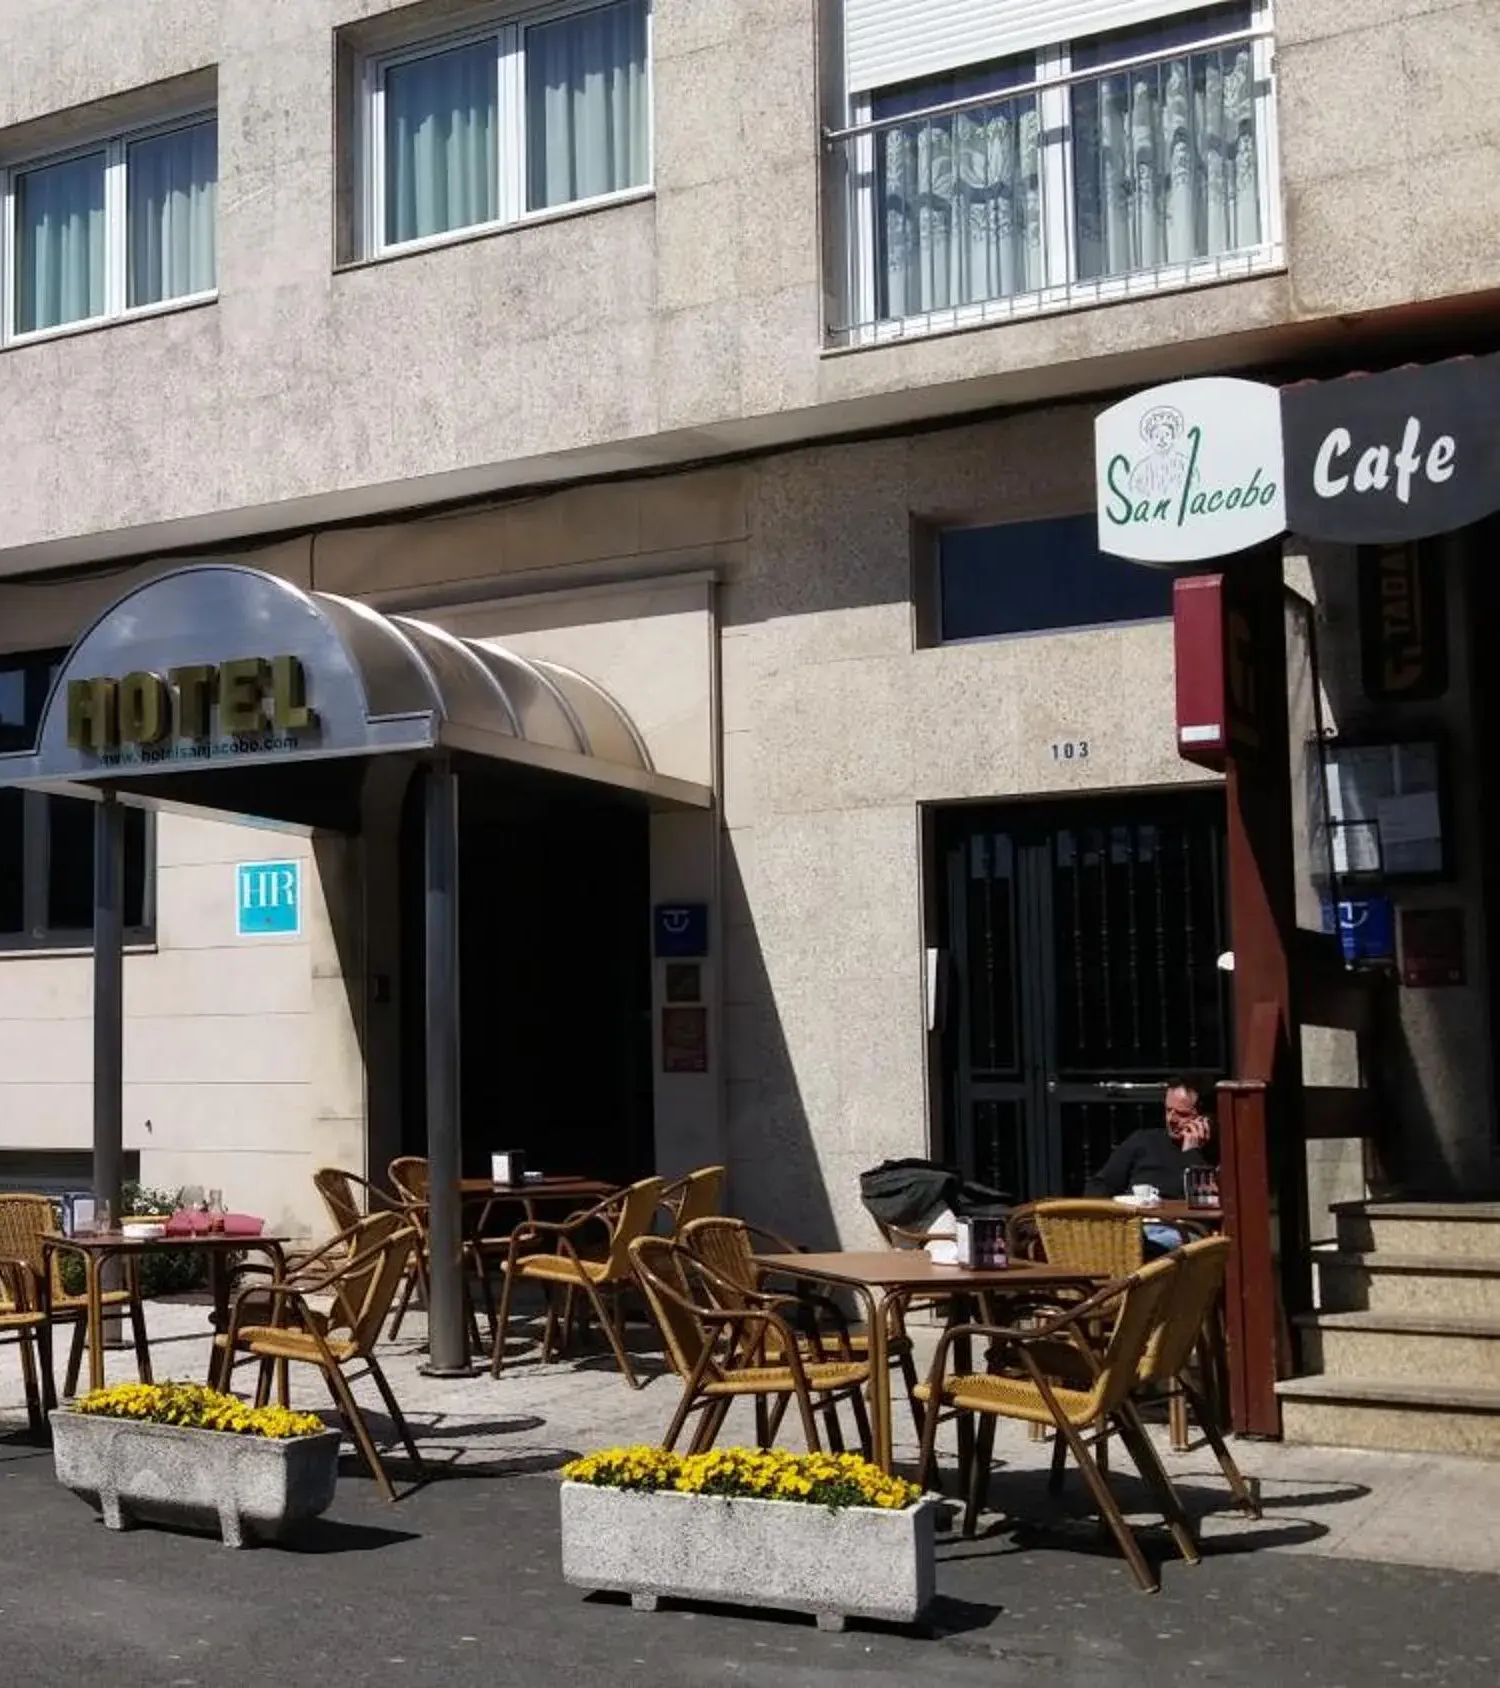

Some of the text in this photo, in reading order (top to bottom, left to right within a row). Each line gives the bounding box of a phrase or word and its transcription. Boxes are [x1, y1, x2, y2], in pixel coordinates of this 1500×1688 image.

[1106, 455, 1169, 525] San
[1313, 416, 1456, 504] Cafe
[67, 655, 315, 748] HOTEL
[1052, 741, 1089, 761] 103
[241, 869, 296, 910] HR
